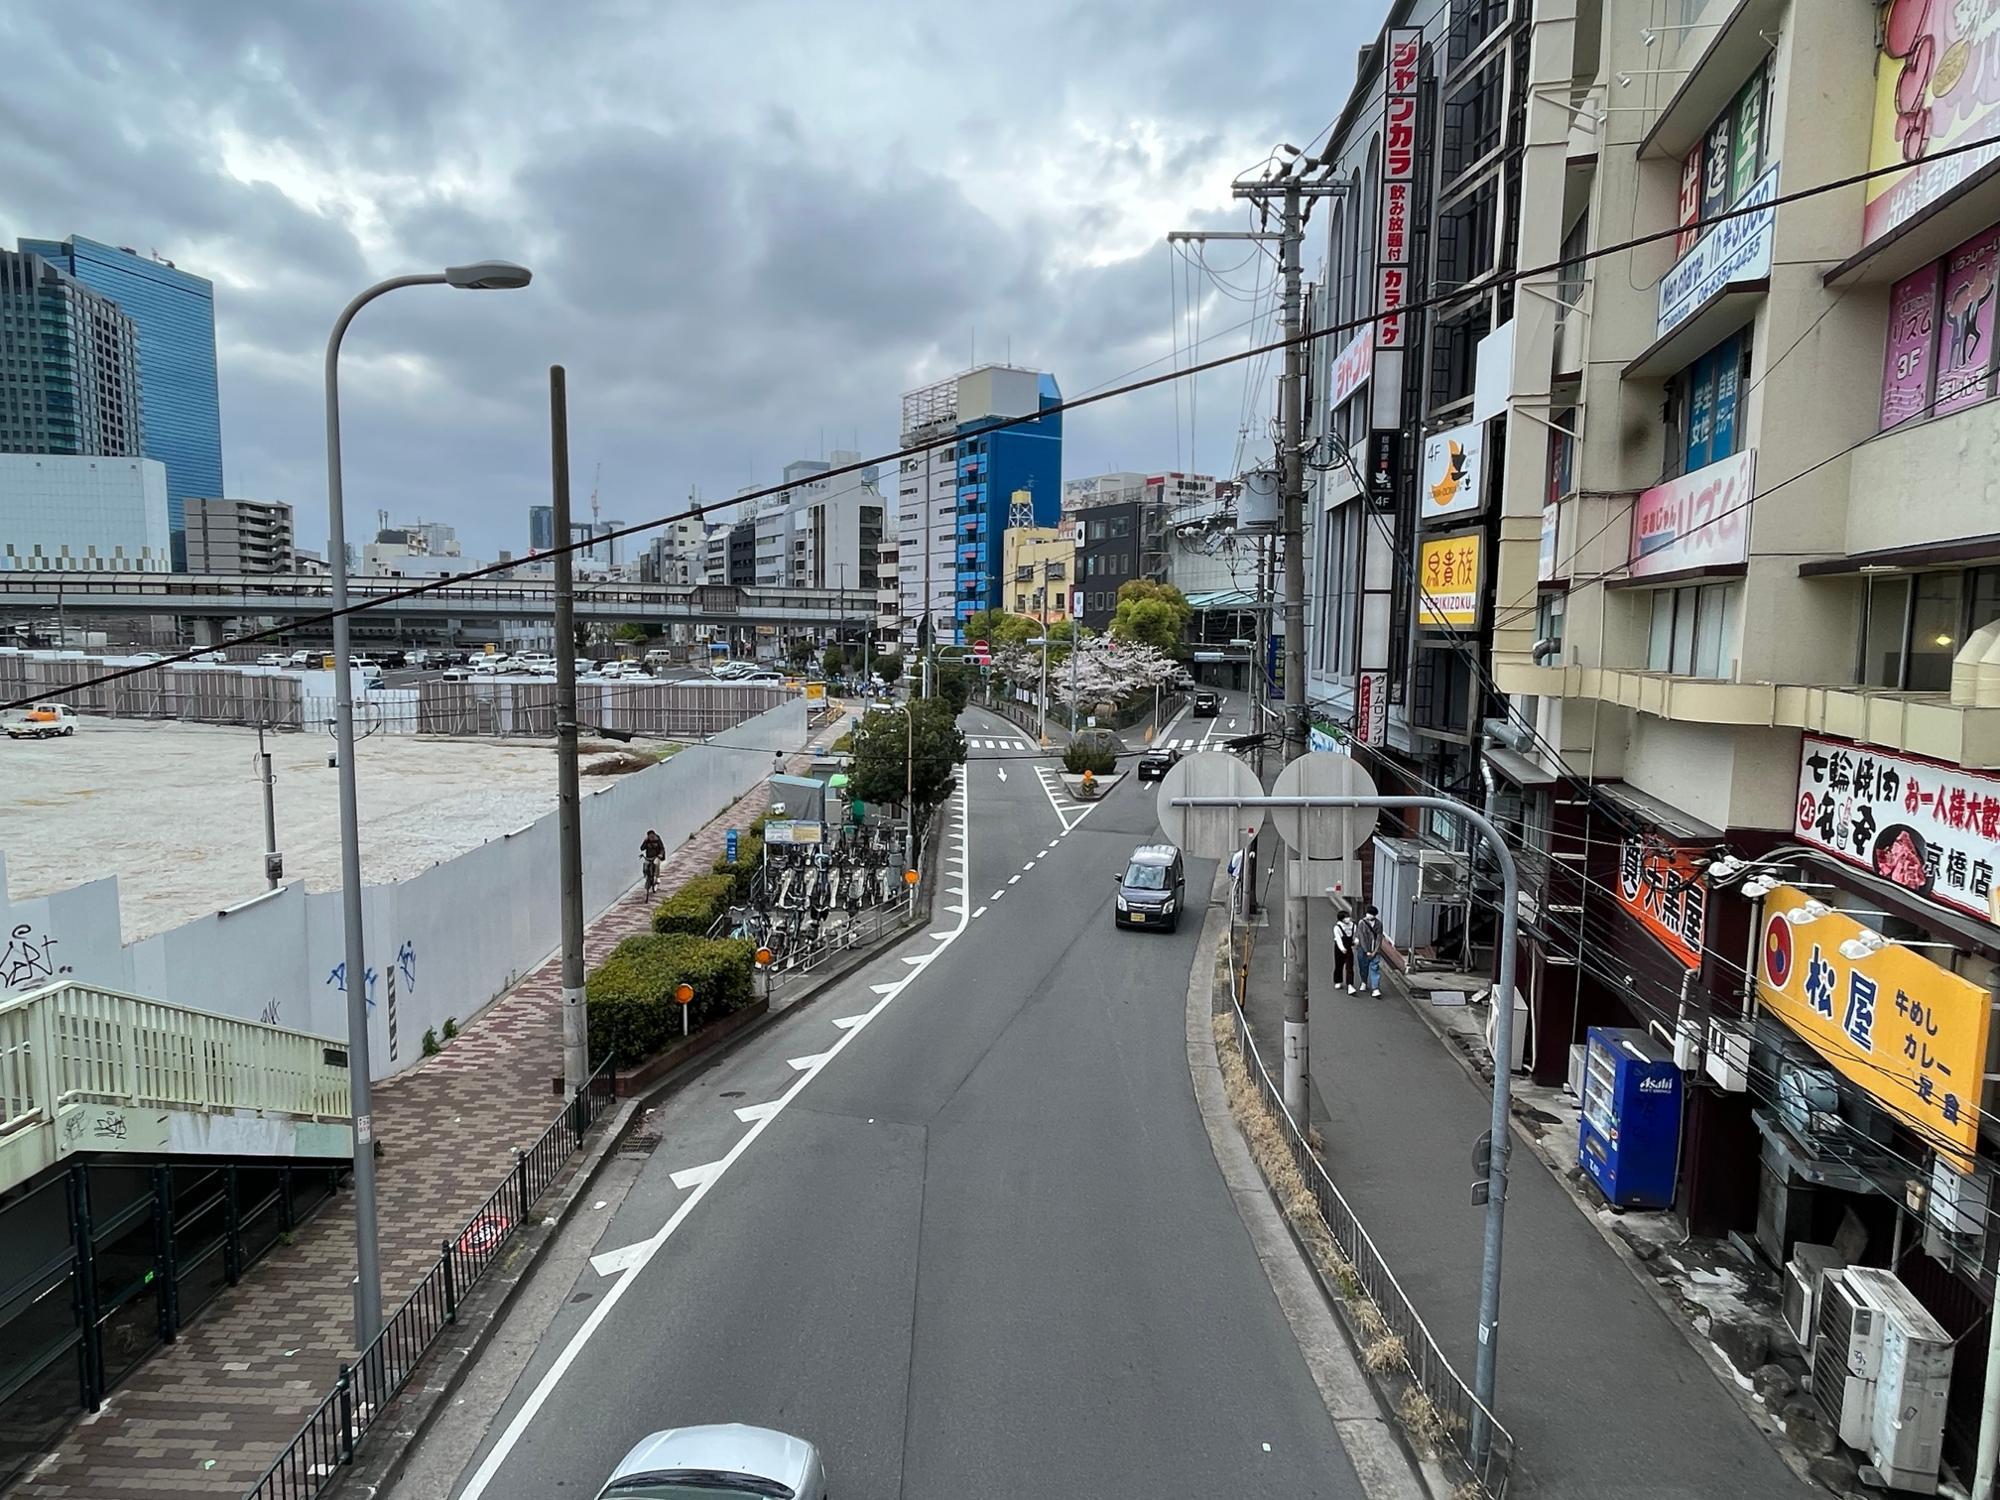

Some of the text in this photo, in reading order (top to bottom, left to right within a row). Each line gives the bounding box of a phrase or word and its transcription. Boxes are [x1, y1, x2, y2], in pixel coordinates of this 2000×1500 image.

[1388, 40, 1417, 176] ジャンカラ
[1387, 184, 1406, 262] 飲み放題付
[1897, 347, 1921, 380] 3F
[1427, 443, 1441, 463] 4F
[1375, 496, 1390, 507] 4F
[1806, 751, 1901, 803] 七輪焼肉
[1801, 797, 1816, 820] 2F
[1923, 841, 1993, 900] 京橋店
[1644, 856, 1704, 954] 大黒屋
[1805, 943, 1878, 1054] 松屋
[1895, 989, 1938, 1036] 牛めし
[1903, 1033, 1951, 1076] カレー
[1640, 1077, 1673, 1089] Asahi
